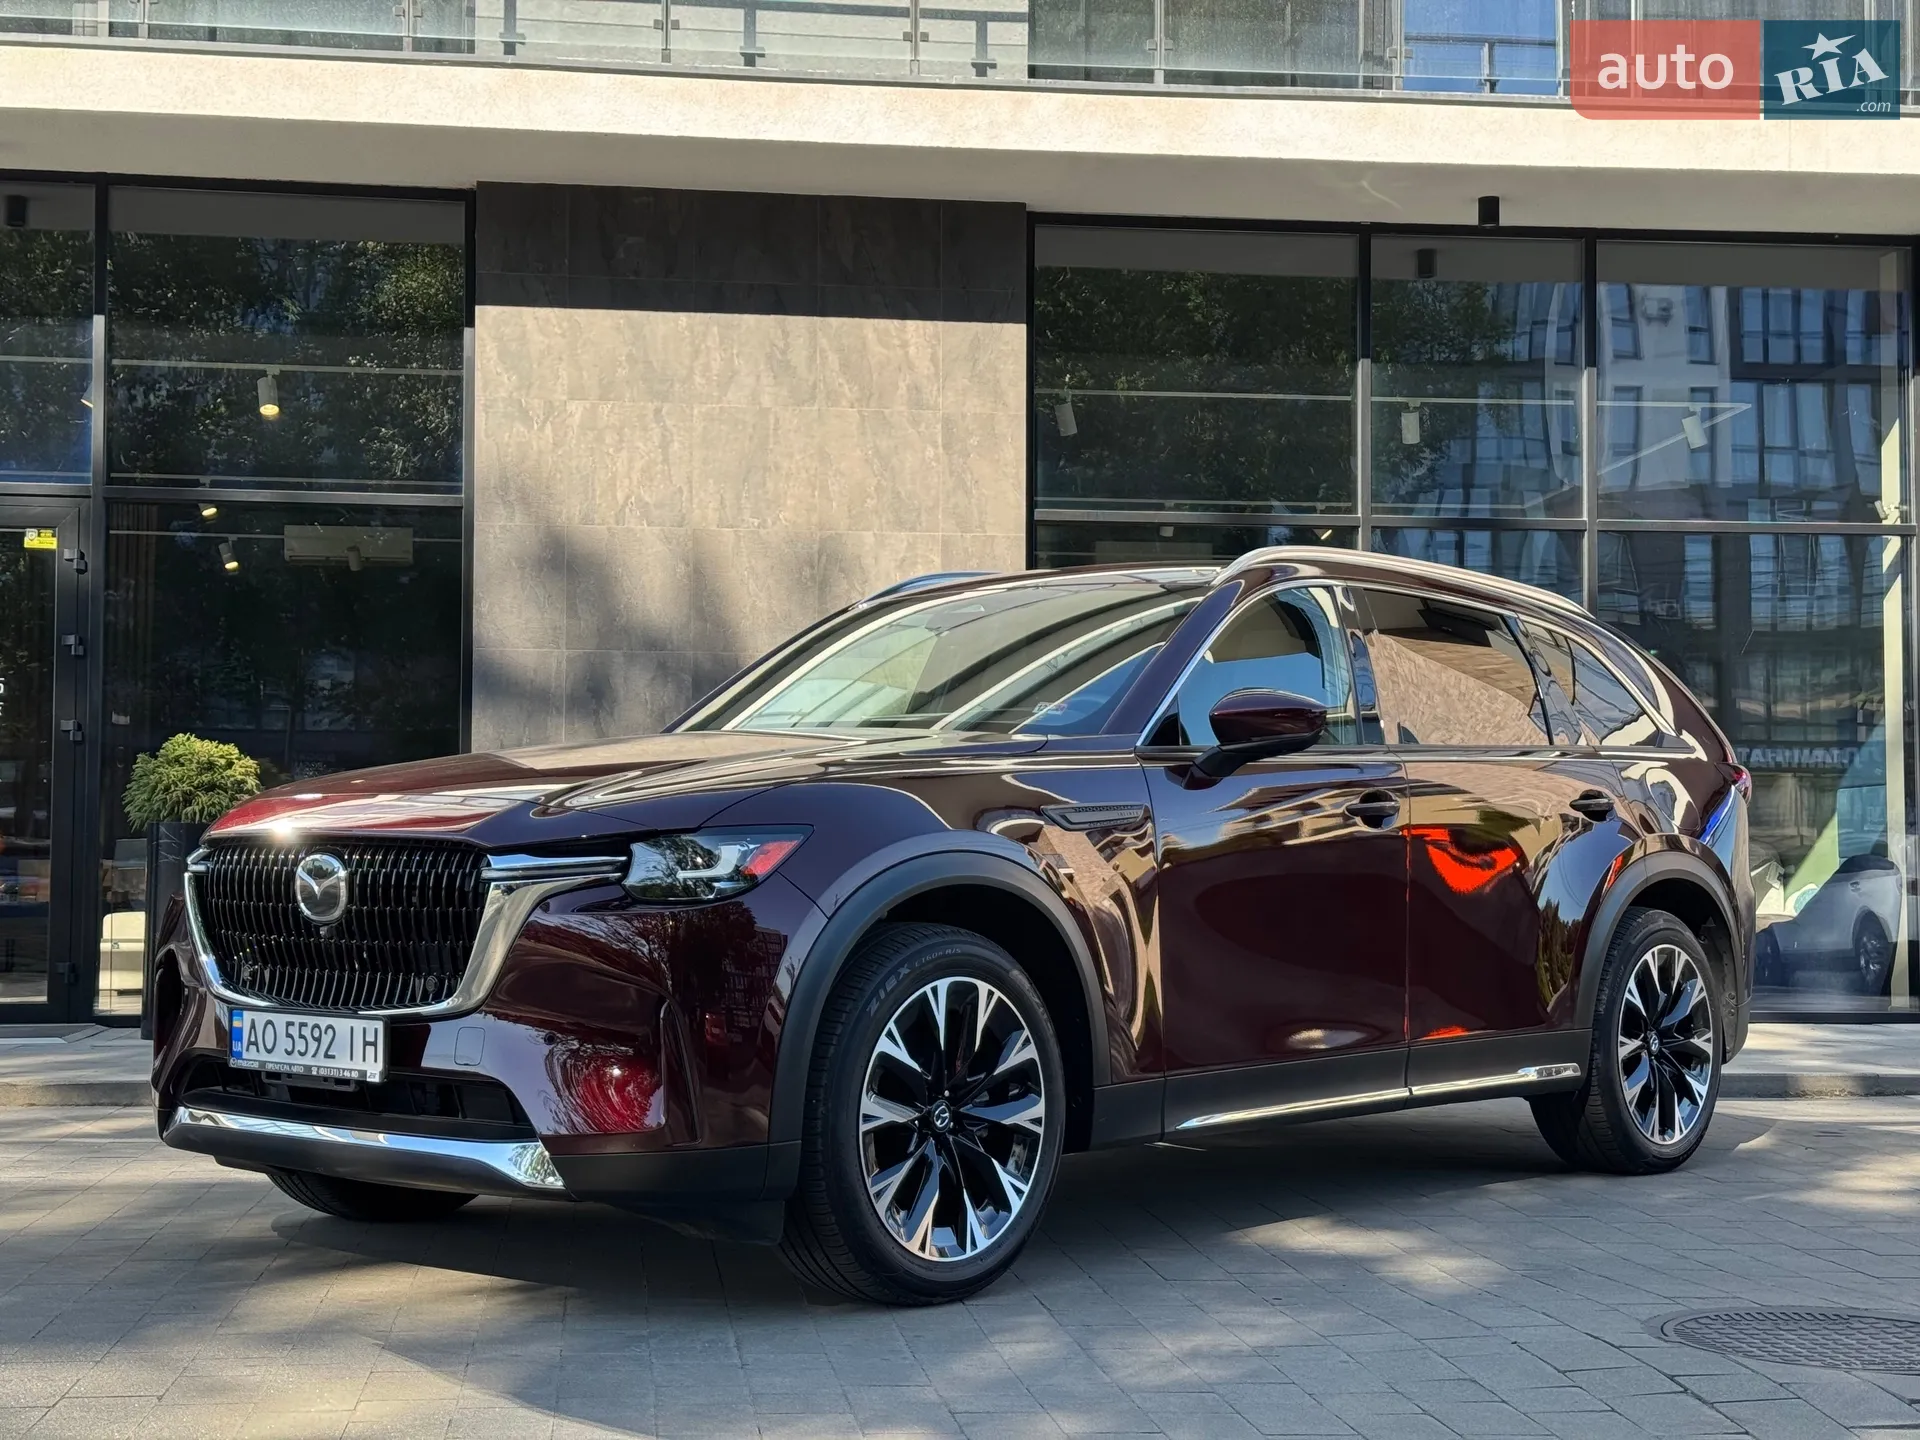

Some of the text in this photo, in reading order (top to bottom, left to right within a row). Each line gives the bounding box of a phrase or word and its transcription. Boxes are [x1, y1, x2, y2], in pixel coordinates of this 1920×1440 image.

[866, 961, 911, 1016] ZIEX
[232, 1040, 242, 1052] UA
[245, 1018, 379, 1063] AO 5592 IH
